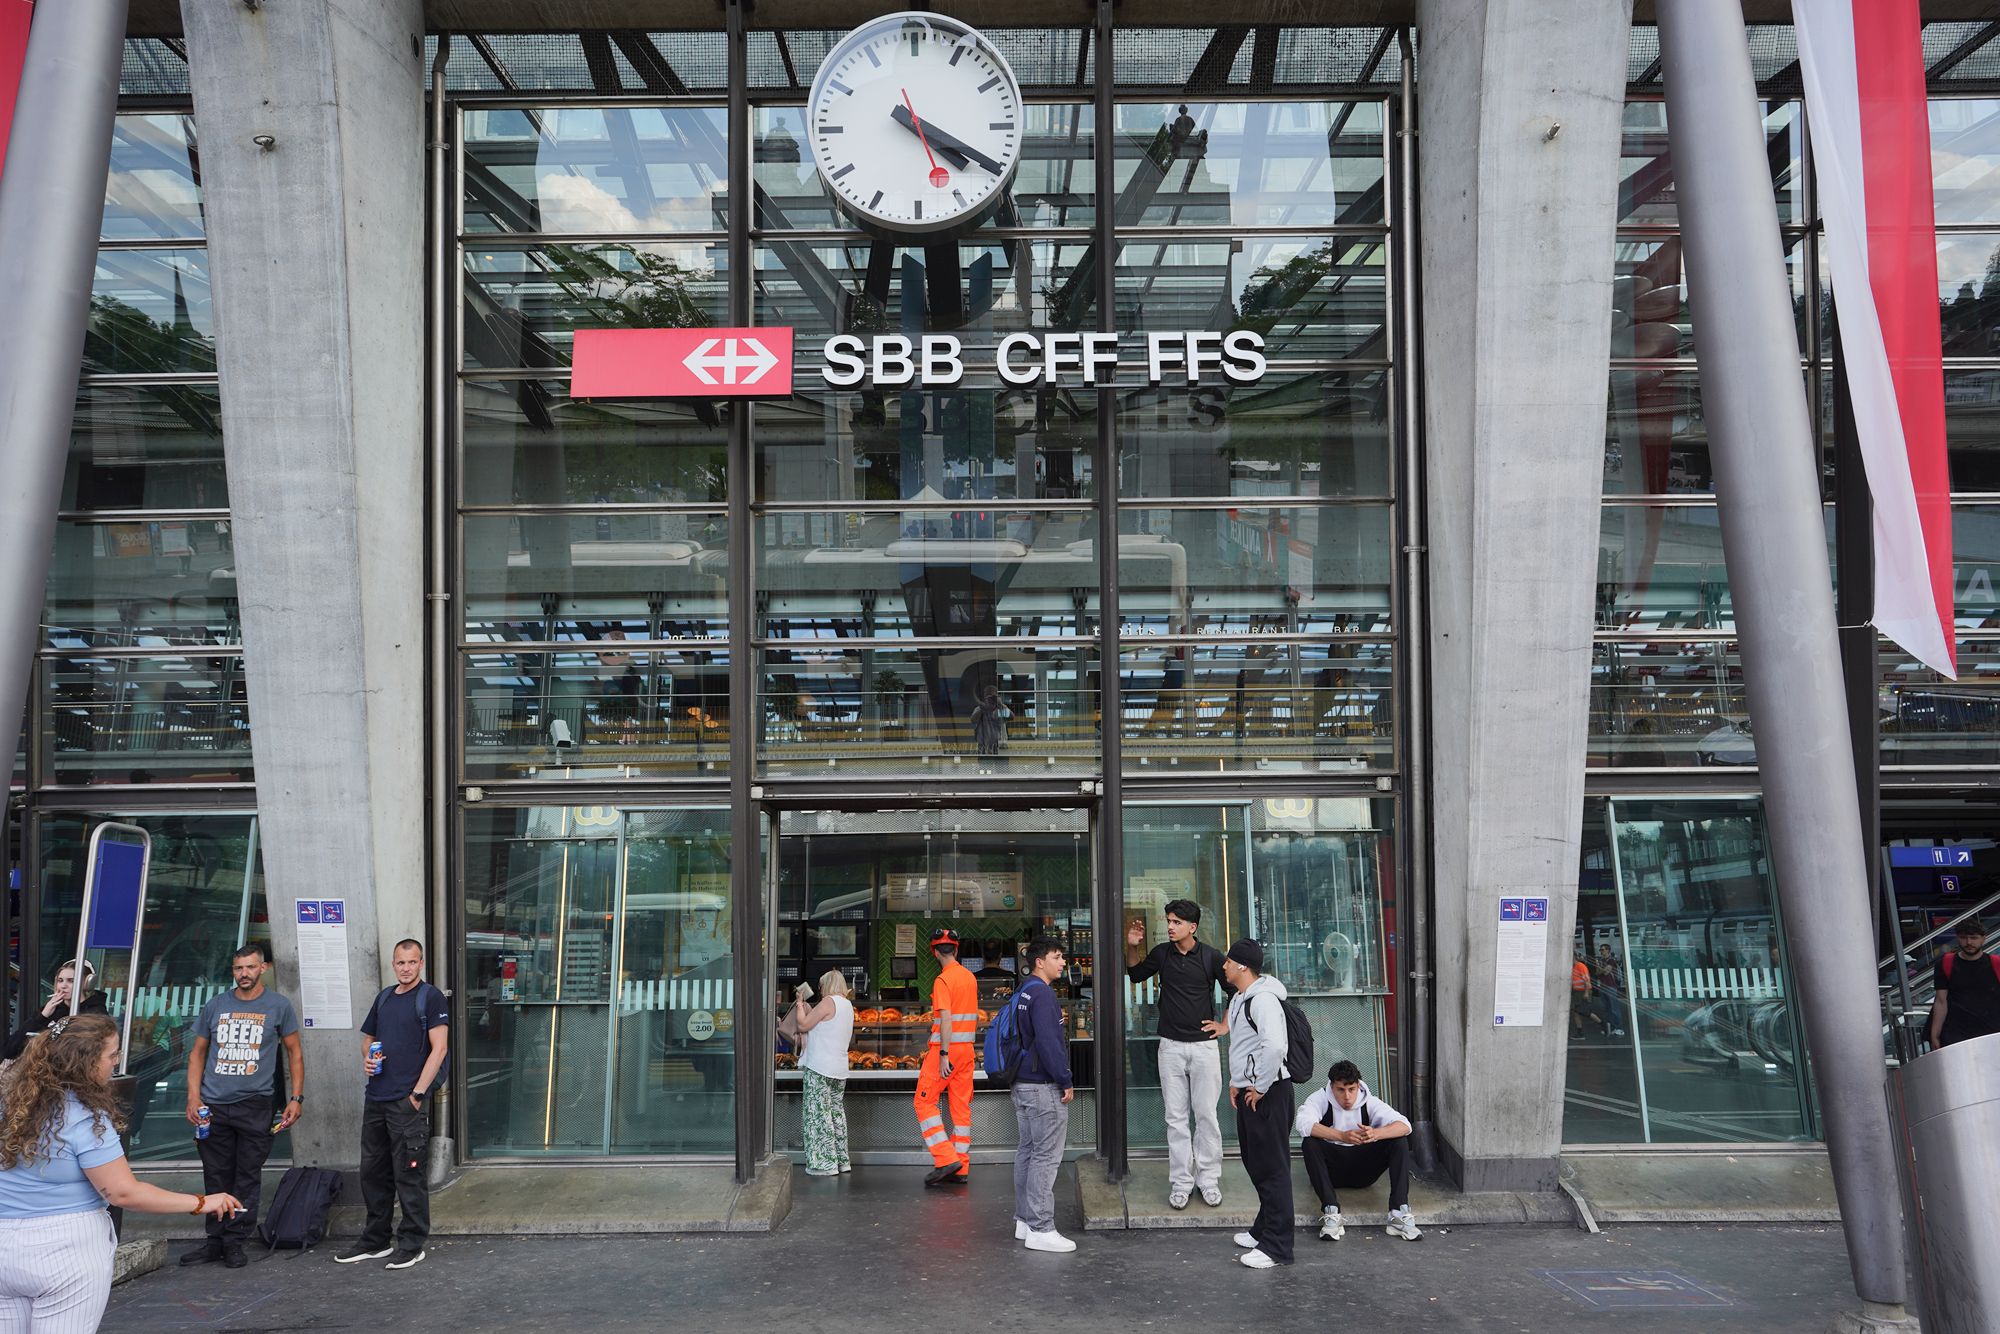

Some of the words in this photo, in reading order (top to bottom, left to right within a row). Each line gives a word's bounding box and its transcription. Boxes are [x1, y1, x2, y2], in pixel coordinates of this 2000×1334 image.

[821, 334, 964, 387] SBB
[997, 332, 1118, 386] CFF
[1148, 330, 1267, 384] FFS
[1092, 622, 1156, 636] tits
[1196, 626, 1288, 635] RESTAURANT
[1334, 625, 1360, 634] BAR
[1946, 880, 1955, 891] 6
[217, 1024, 264, 1044] BEER
[695, 1024, 712, 1032] 2.00
[217, 1048, 259, 1060] OPINION
[214, 1062, 246, 1075] BEER
